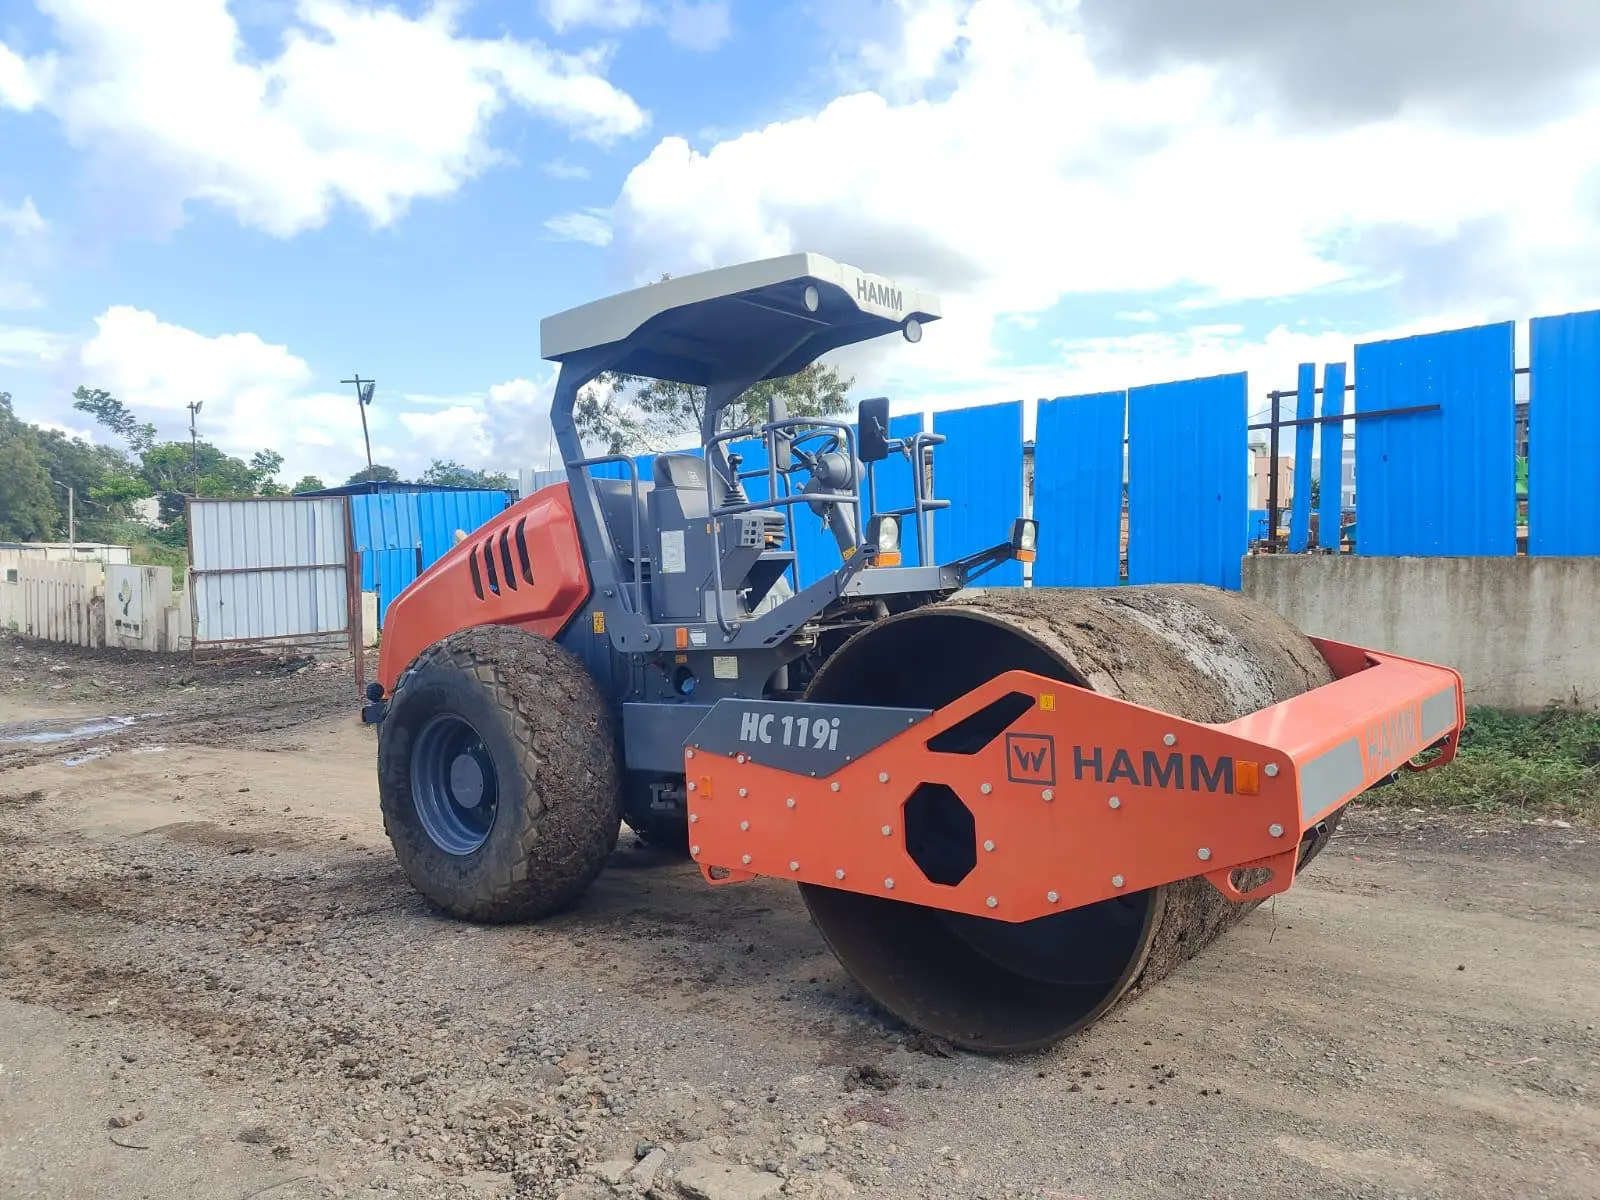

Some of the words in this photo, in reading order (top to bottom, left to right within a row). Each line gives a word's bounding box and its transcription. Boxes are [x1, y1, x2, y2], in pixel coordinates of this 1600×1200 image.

[856, 277, 903, 311] HAMM
[740, 712, 775, 744] HC
[781, 715, 840, 751] 119i
[1013, 744, 1048, 773] W
[1073, 745, 1234, 794] HAMM
